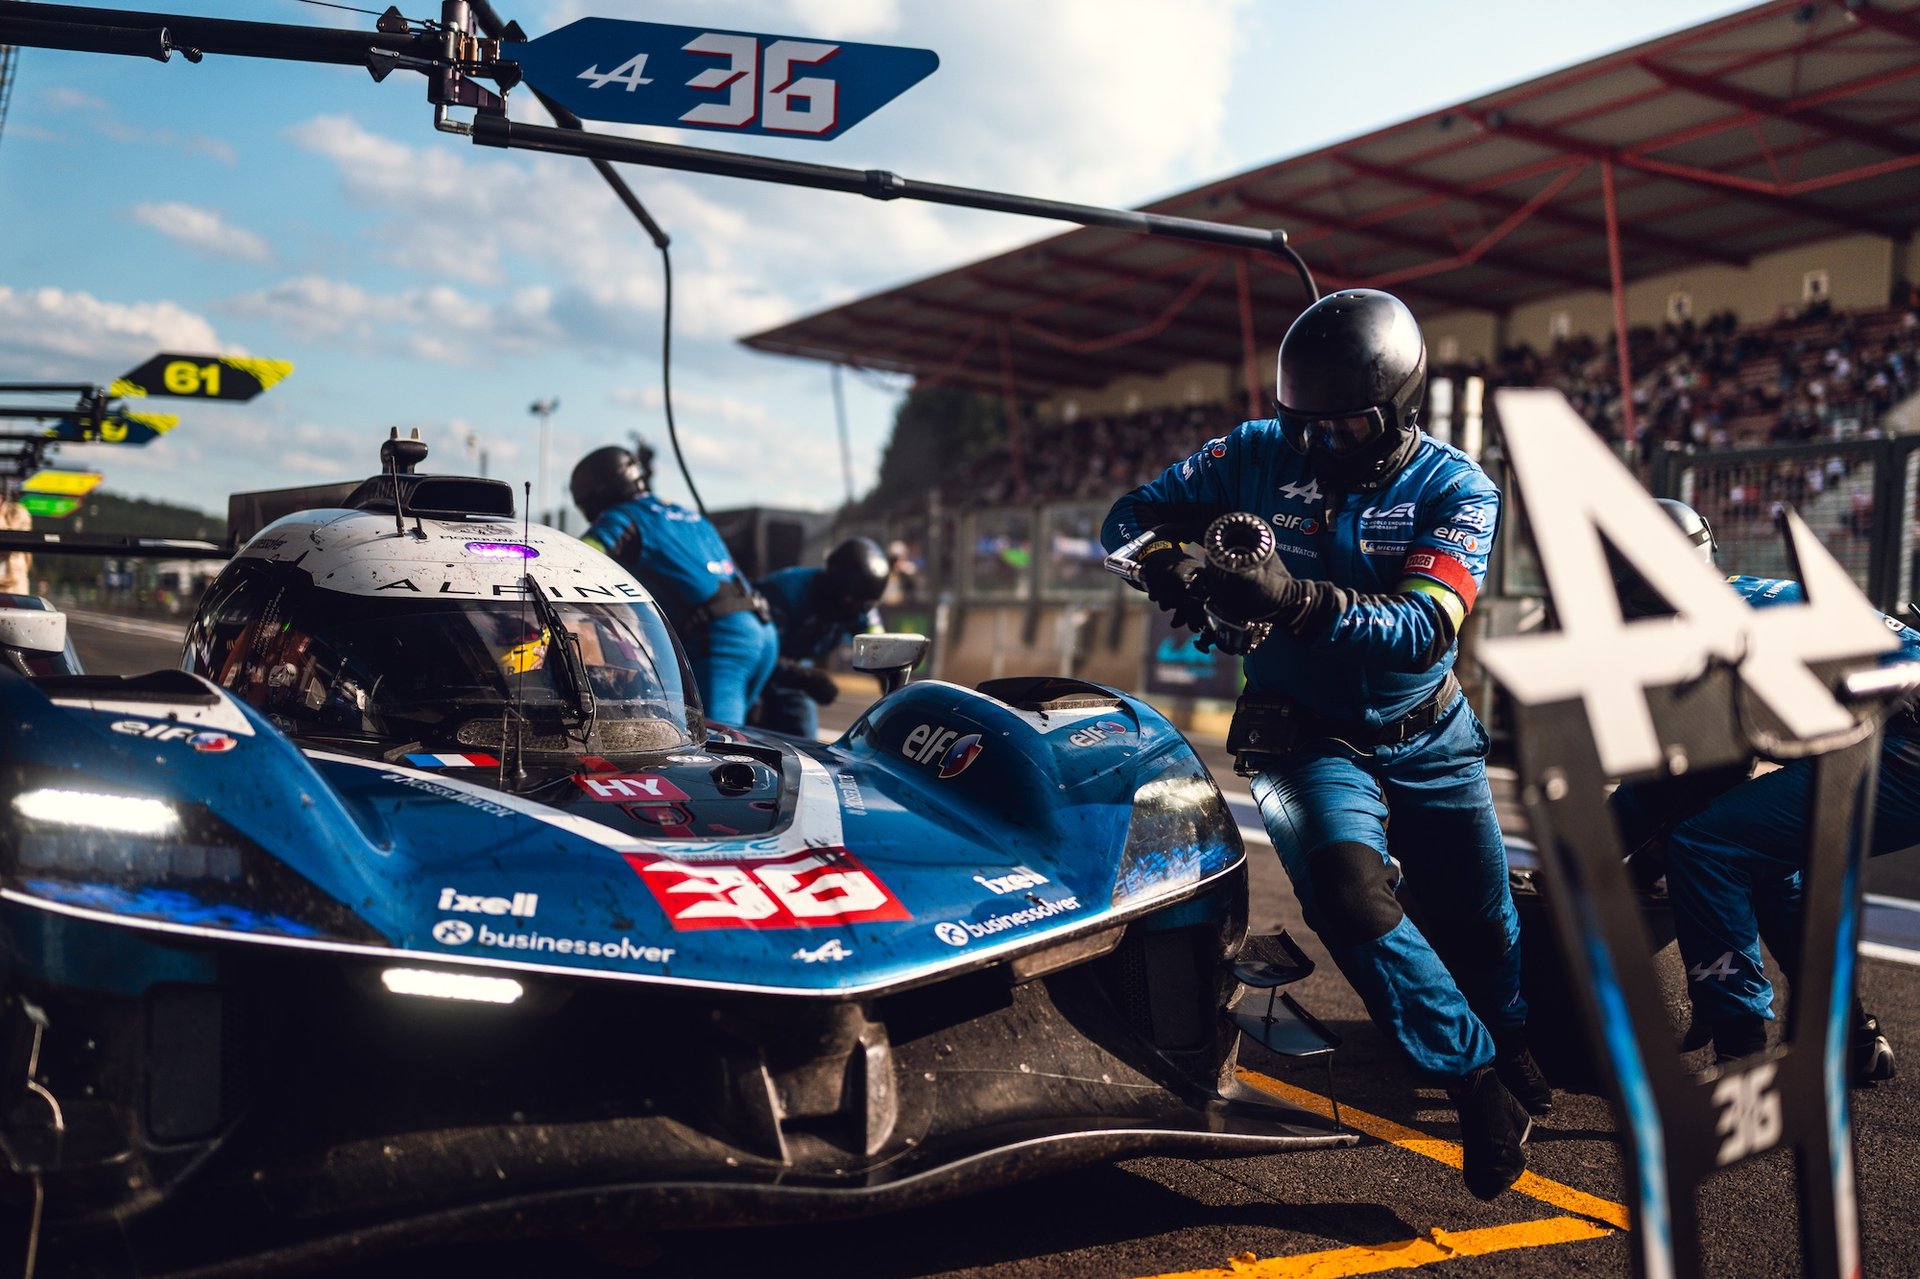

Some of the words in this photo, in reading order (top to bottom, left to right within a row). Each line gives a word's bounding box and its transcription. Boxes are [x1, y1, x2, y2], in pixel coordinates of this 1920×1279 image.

[678, 33, 842, 136] 36
[164, 360, 221, 396] 61
[1272, 512, 1302, 529] elf
[1433, 527, 1466, 544] elf
[374, 578, 642, 598] ALPINE
[110, 720, 192, 743] elf
[901, 723, 957, 765] elf
[1068, 725, 1105, 748] elf
[584, 778, 664, 797] HY
[643, 856, 889, 920] 36
[973, 866, 1050, 896] ixell
[437, 887, 539, 918] ixell
[964, 894, 1082, 939] businessolver
[477, 925, 677, 964] businessolver
[1711, 1061, 1784, 1167] 36
